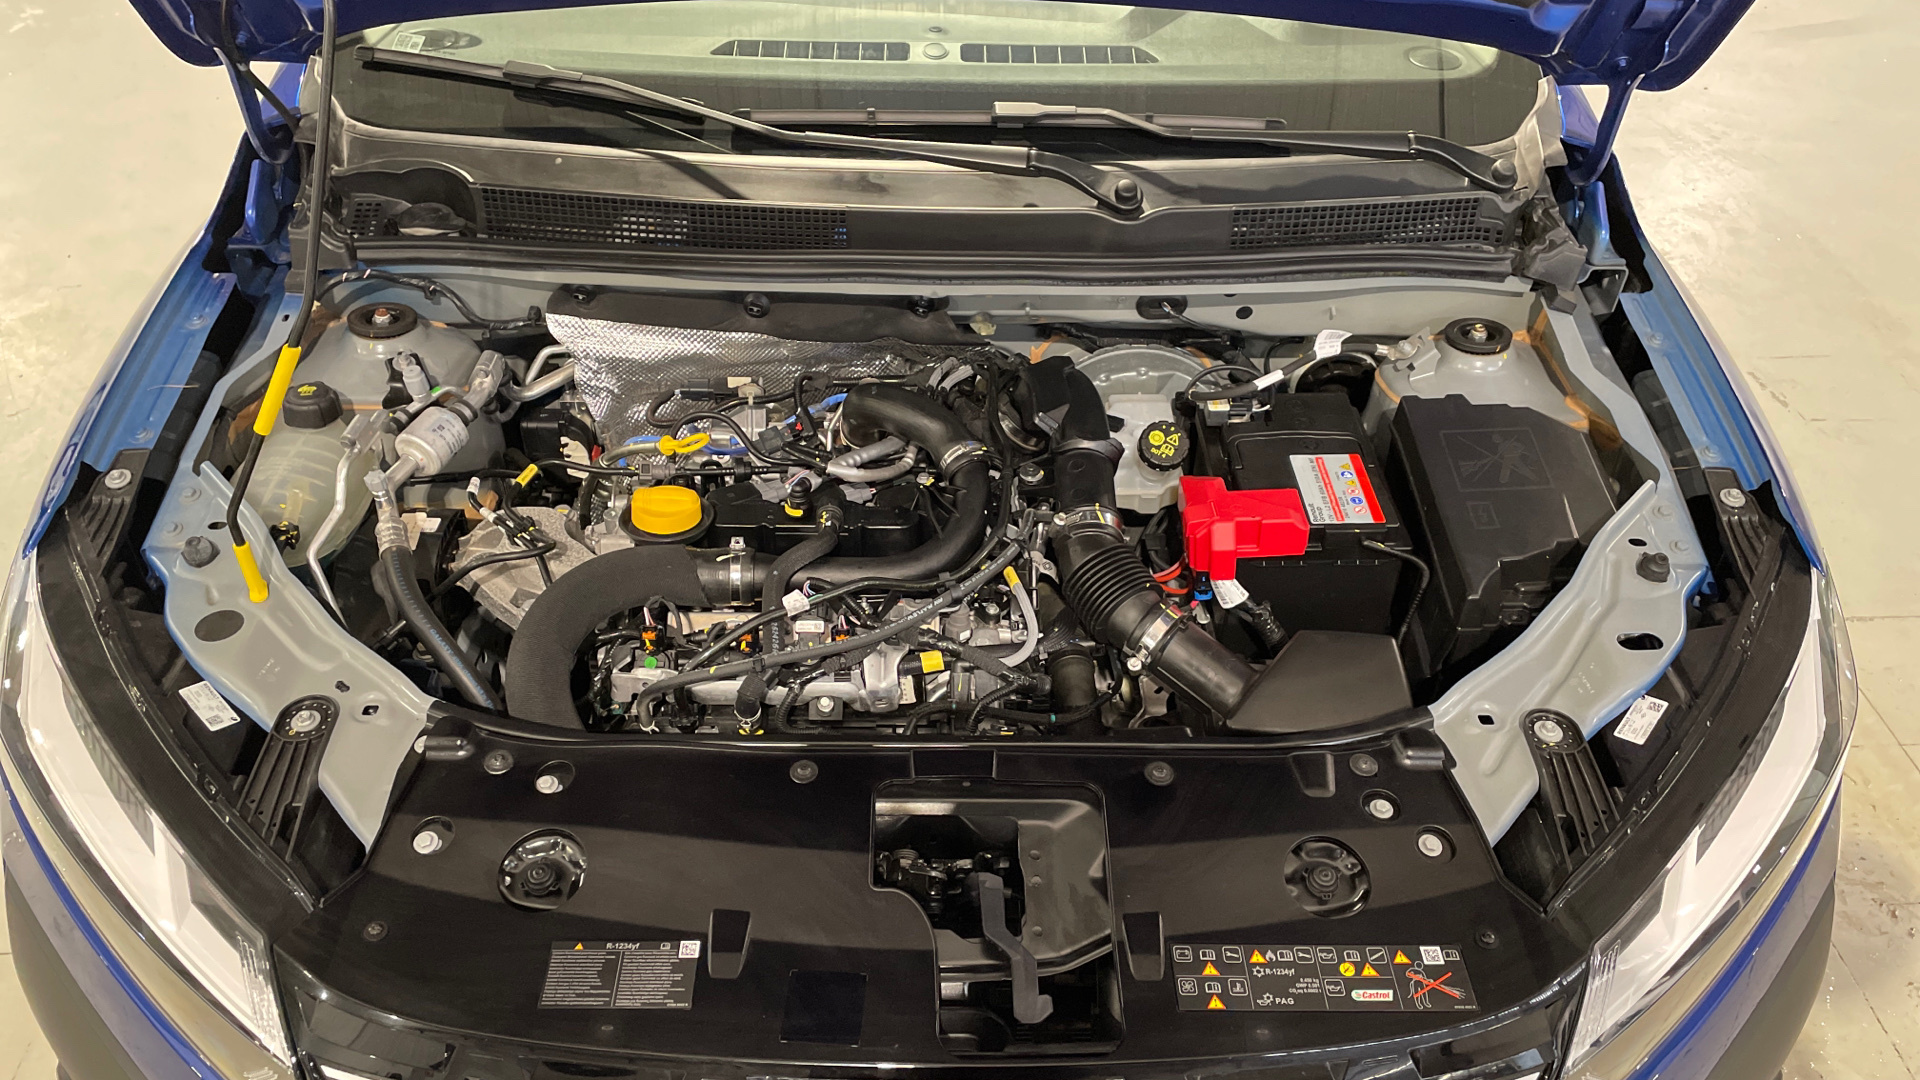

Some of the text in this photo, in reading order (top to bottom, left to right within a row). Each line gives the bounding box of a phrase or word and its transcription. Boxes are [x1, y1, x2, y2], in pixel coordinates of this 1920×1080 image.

[606, 942, 640, 950] R-1234yf
[1265, 968, 1295, 977] R-1234yf
[1362, 991, 1390, 999] Castrol
[1275, 997, 1295, 1005] PAG
